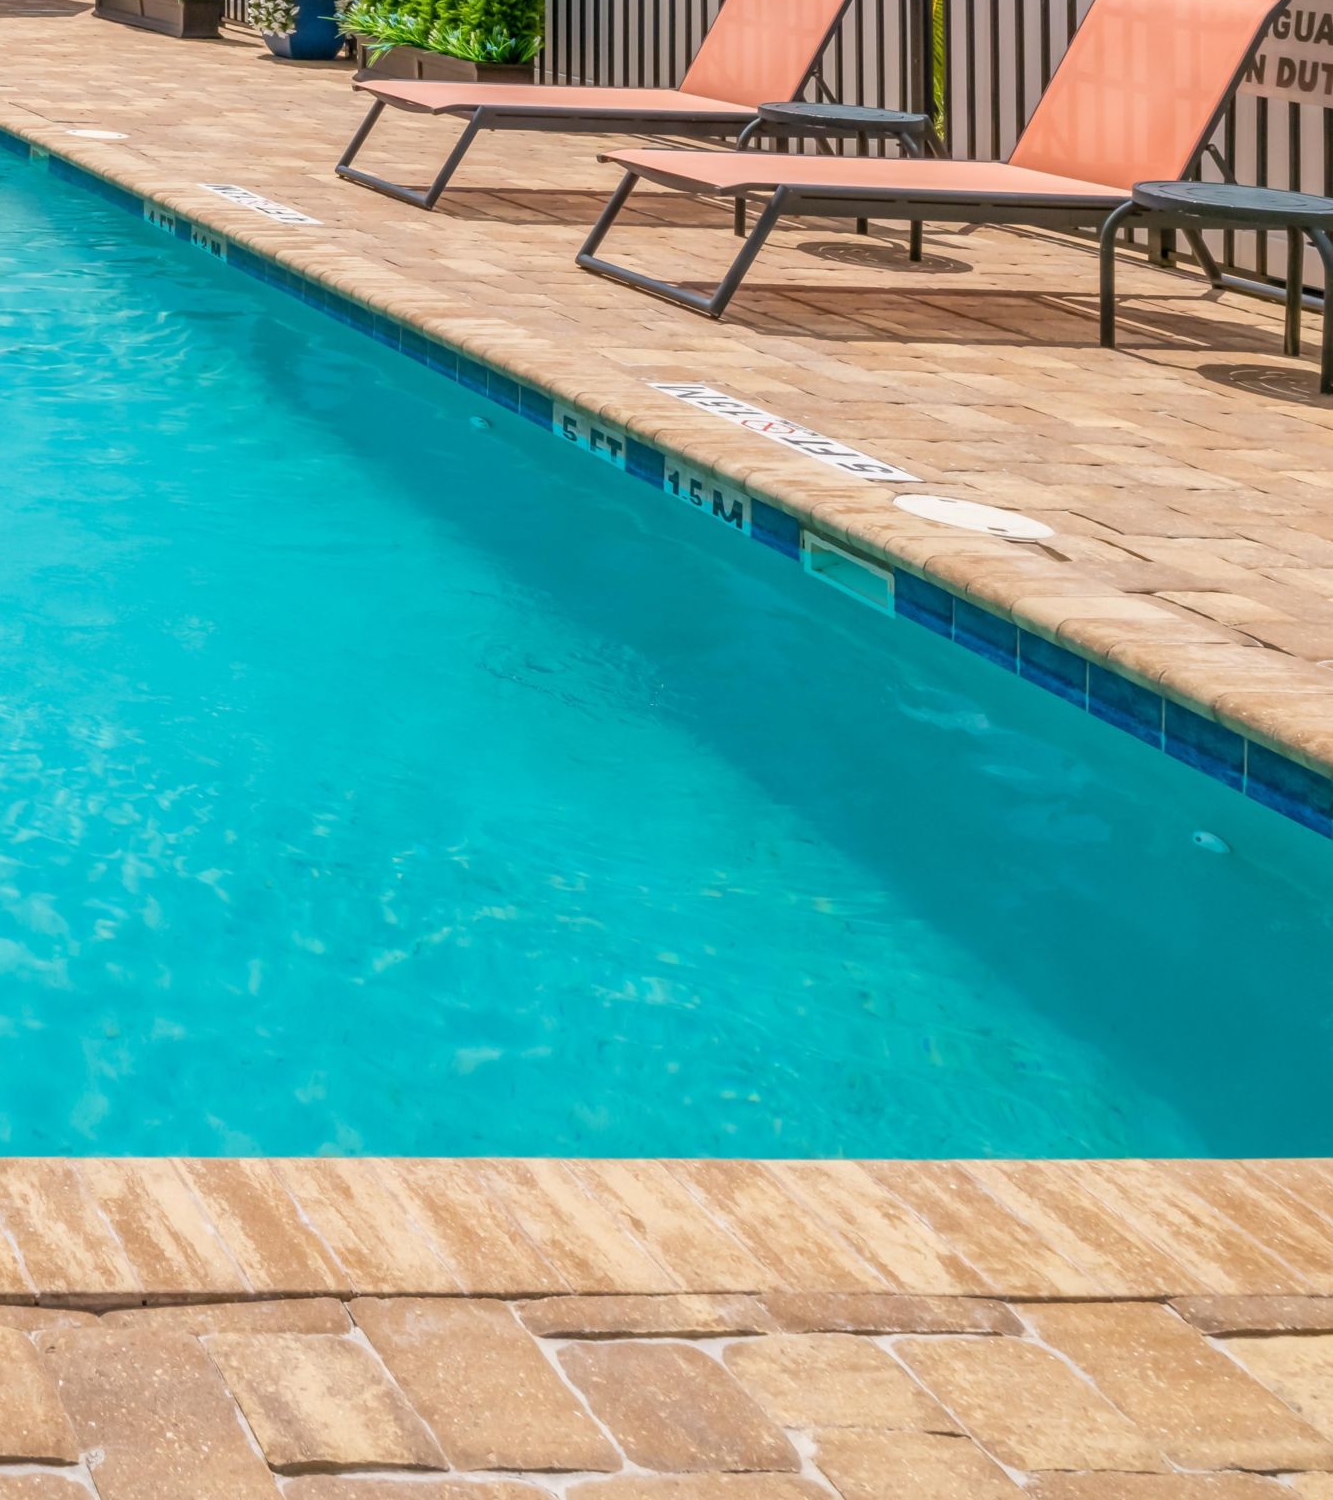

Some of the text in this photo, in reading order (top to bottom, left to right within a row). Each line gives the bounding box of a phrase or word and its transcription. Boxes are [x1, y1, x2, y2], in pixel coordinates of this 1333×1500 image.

[562, 415, 623, 463] 5 FT
[712, 489, 743, 530] M
